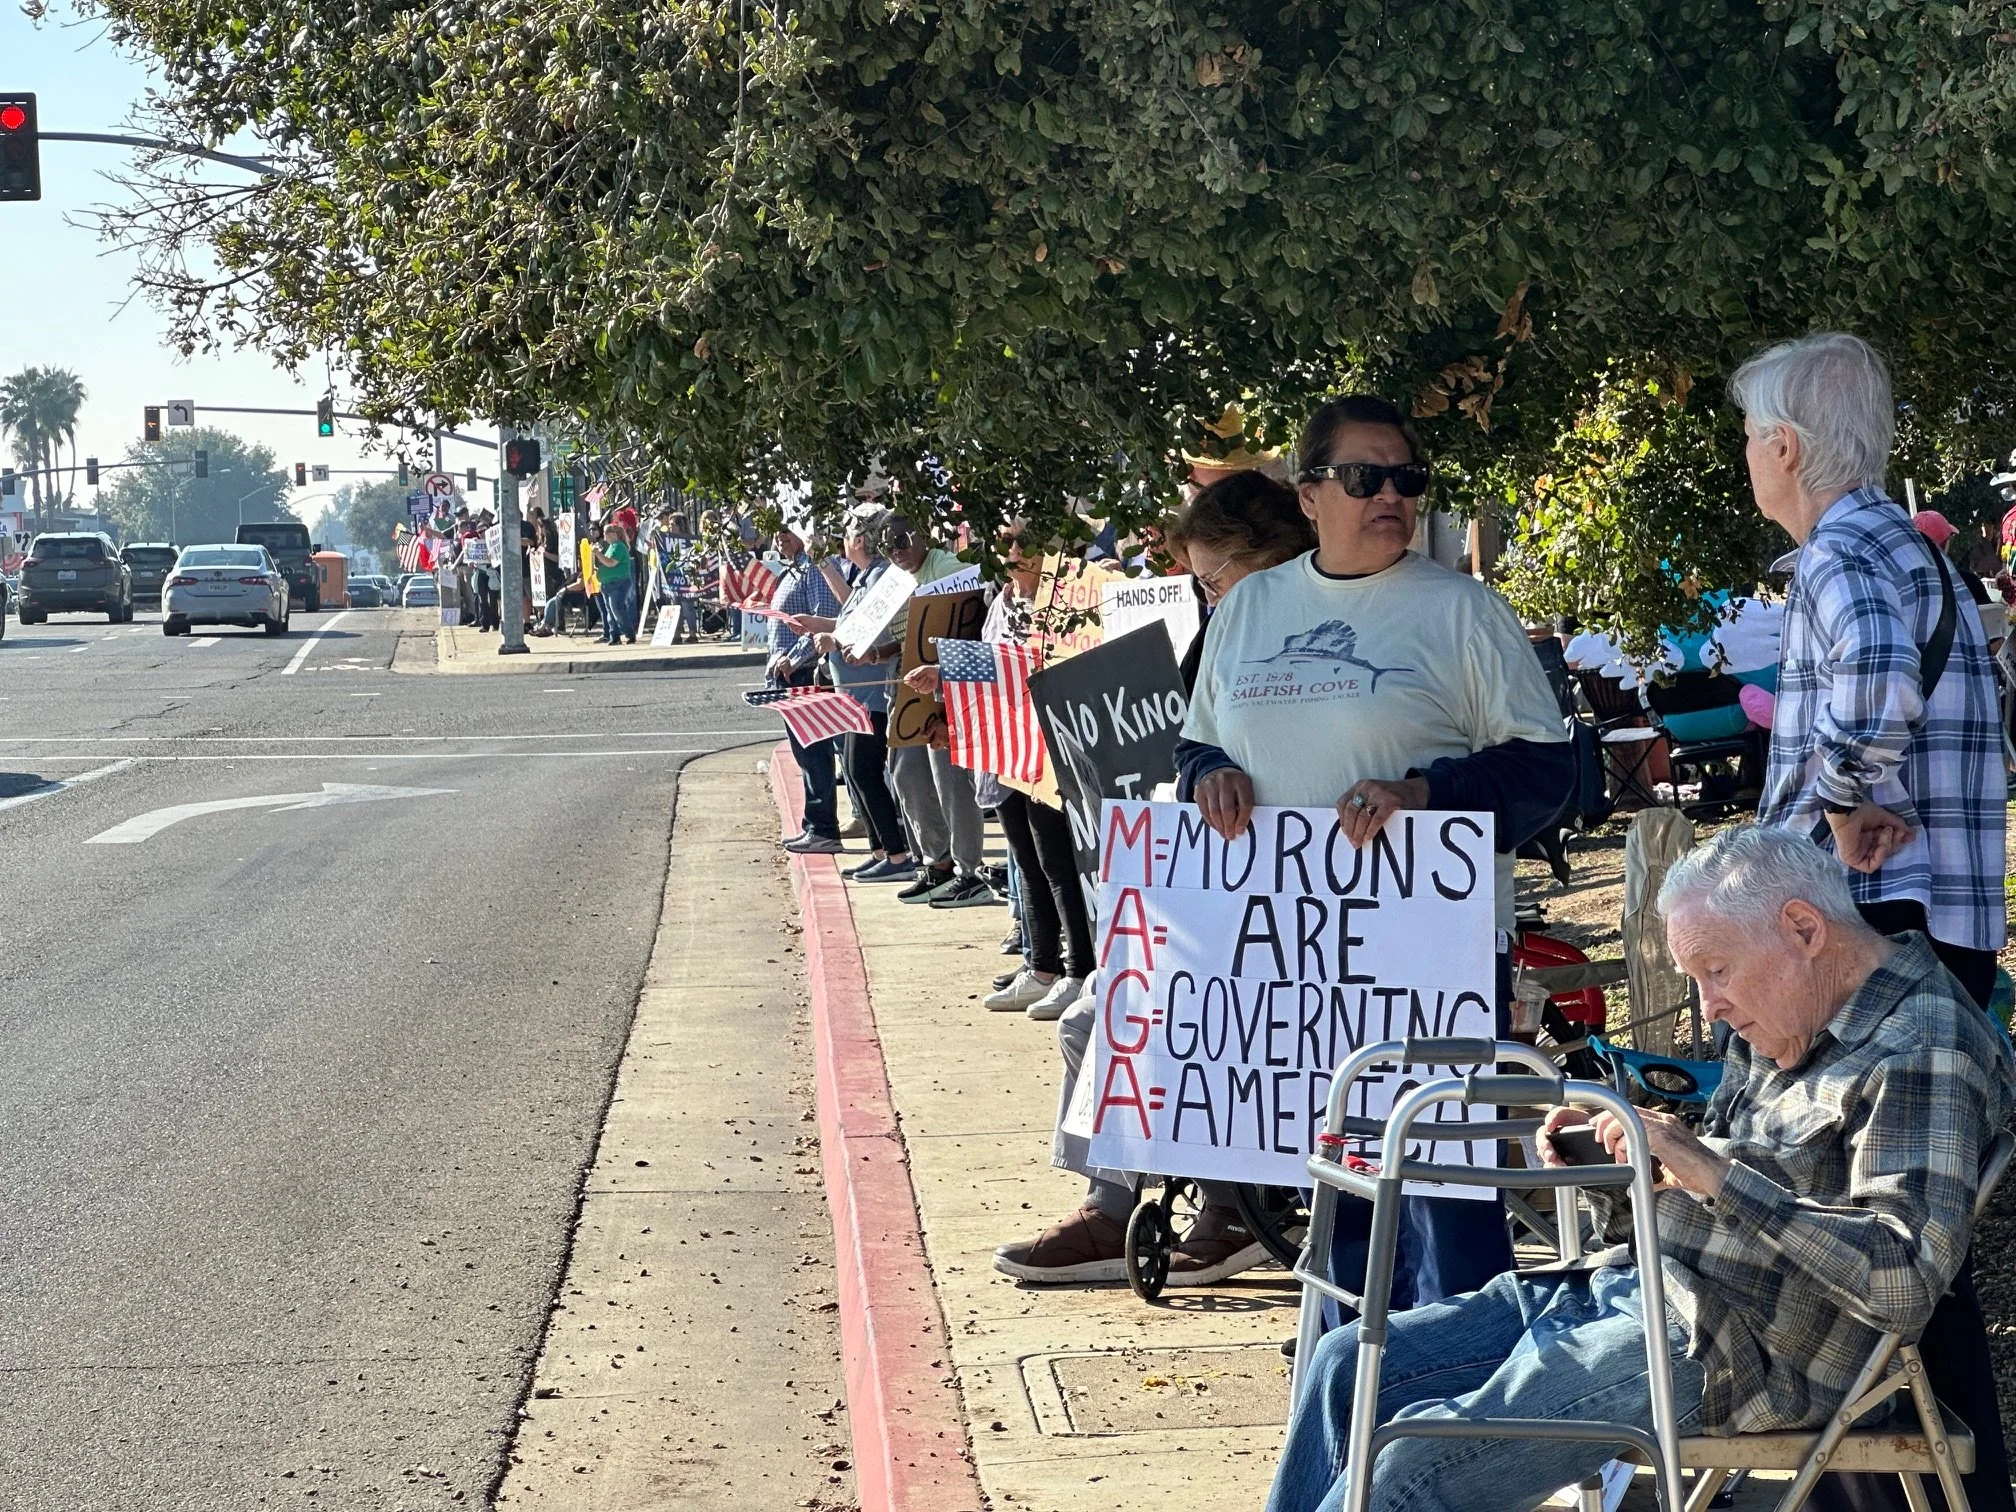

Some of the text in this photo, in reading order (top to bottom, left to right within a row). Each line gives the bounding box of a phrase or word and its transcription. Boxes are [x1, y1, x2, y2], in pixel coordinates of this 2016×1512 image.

[665, 537, 686, 554] WE
[1116, 583, 1182, 608] HANDS OFF!
[748, 612, 768, 624] TO
[1230, 679, 1359, 701] SAILFISH COVE
[1046, 701, 1098, 766] NO
[1231, 895, 1380, 985] ARE
